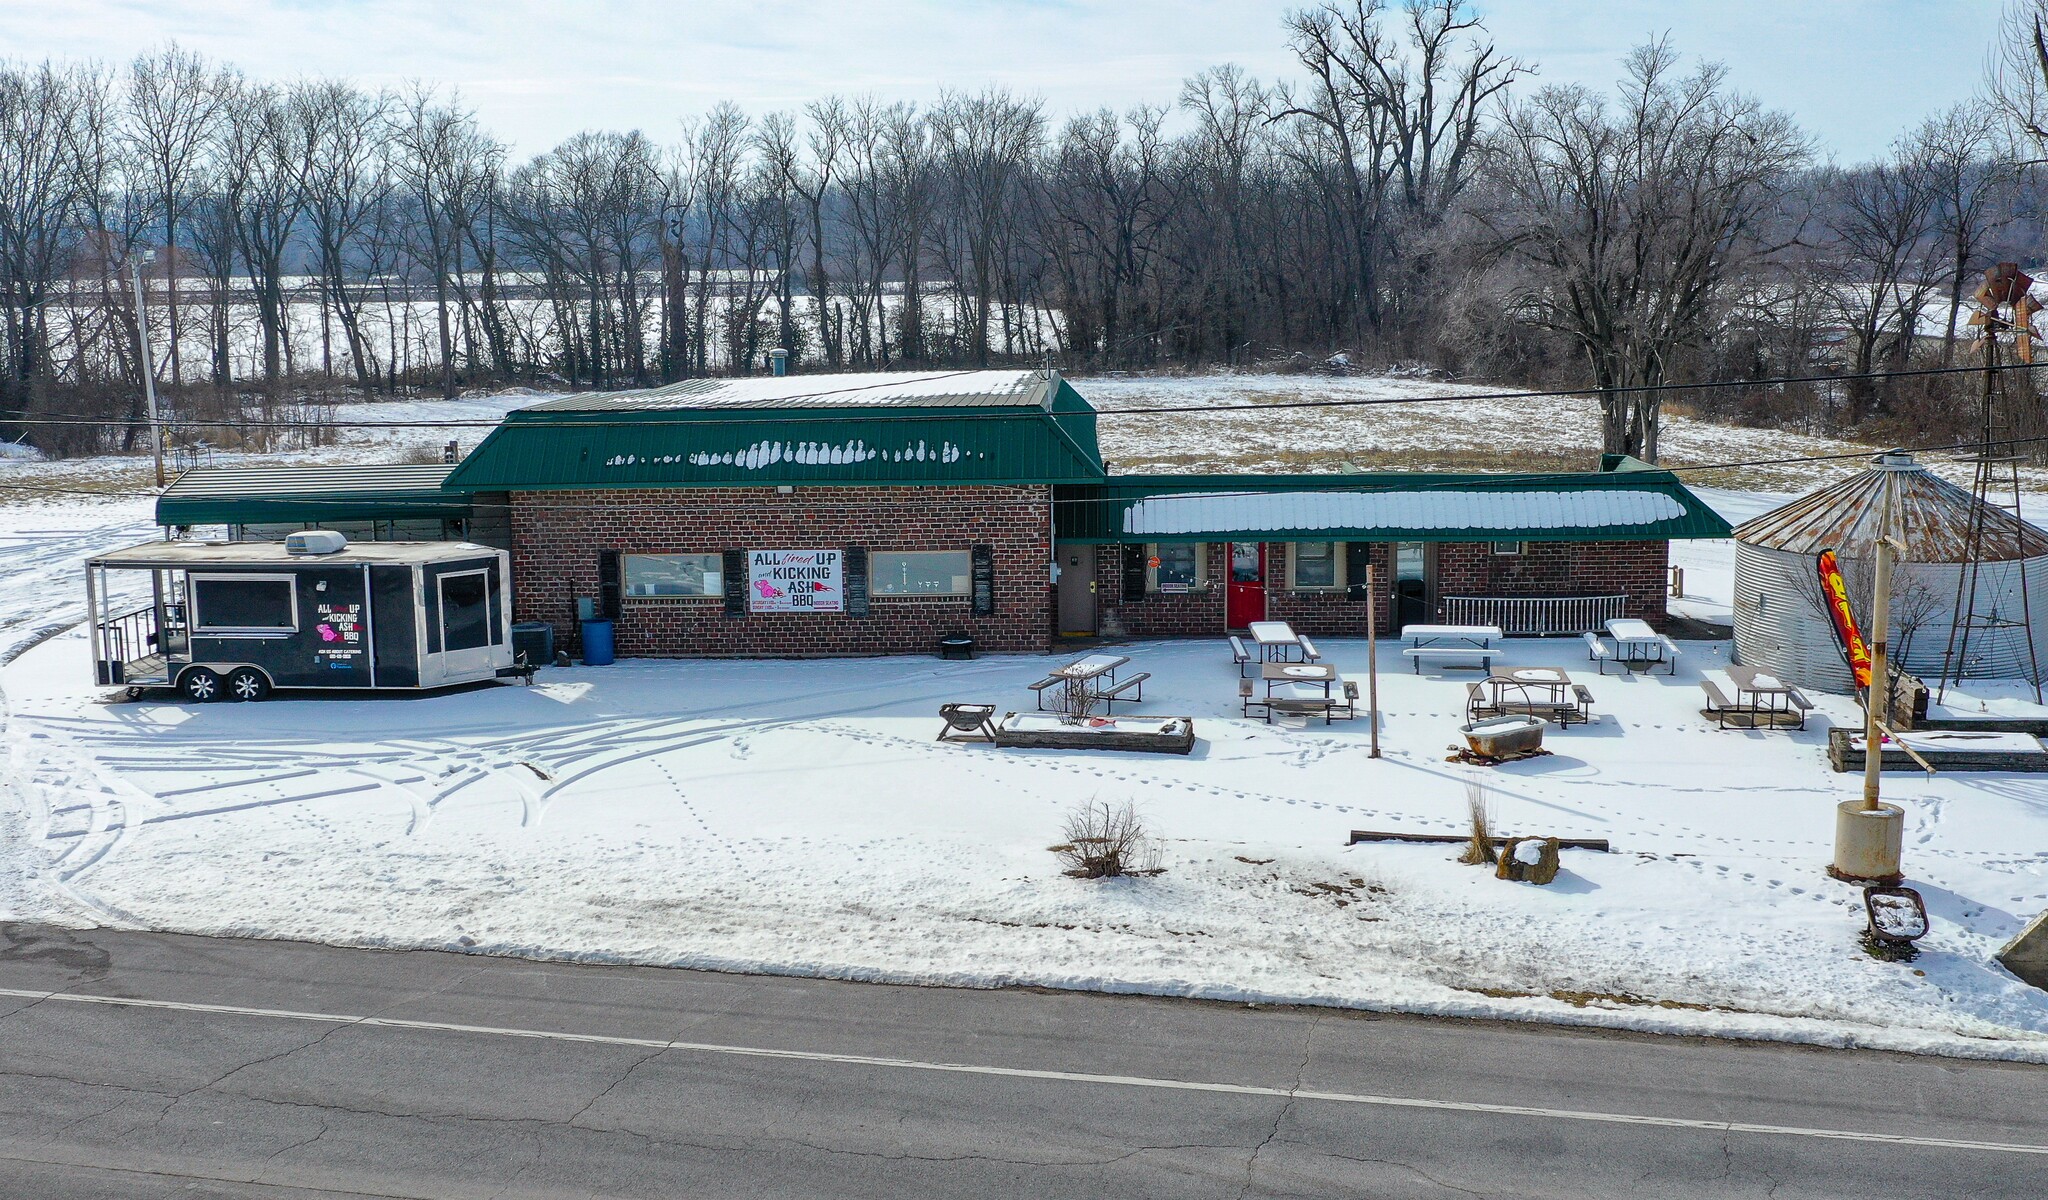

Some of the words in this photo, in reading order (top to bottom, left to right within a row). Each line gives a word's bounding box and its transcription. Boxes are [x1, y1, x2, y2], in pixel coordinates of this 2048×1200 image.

[754, 552, 780, 565] ALL
[781, 553, 814, 566] fired
[816, 552, 836, 565] UP
[758, 570, 772, 579] and
[773, 566, 831, 580] KICKING
[788, 581, 814, 594] ASH
[792, 594, 814, 607] BBQ
[318, 604, 331, 613] ALL
[349, 604, 360, 613] UP
[329, 613, 357, 622] KICKING
[338, 622, 353, 631] ASH
[343, 631, 359, 641] BBQ
